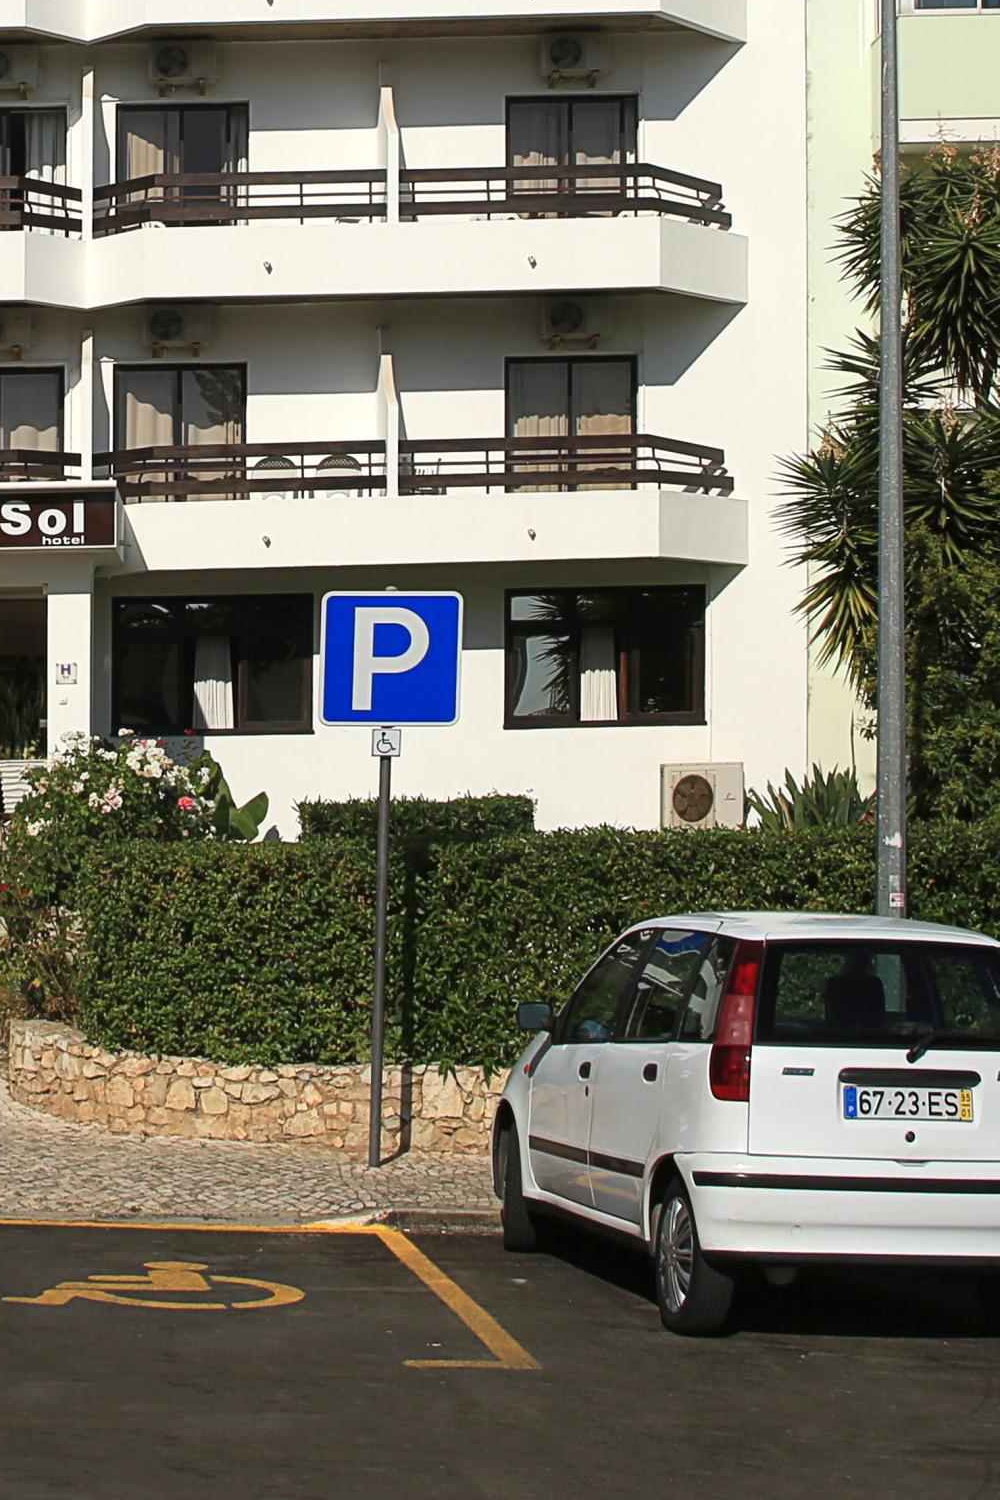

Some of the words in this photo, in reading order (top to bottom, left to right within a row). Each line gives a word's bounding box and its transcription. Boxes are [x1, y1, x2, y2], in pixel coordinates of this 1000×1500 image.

[0, 500, 85, 536] Sol
[42, 535, 85, 546] hotel
[60, 663, 71, 675] H
[352, 606, 430, 711] P
